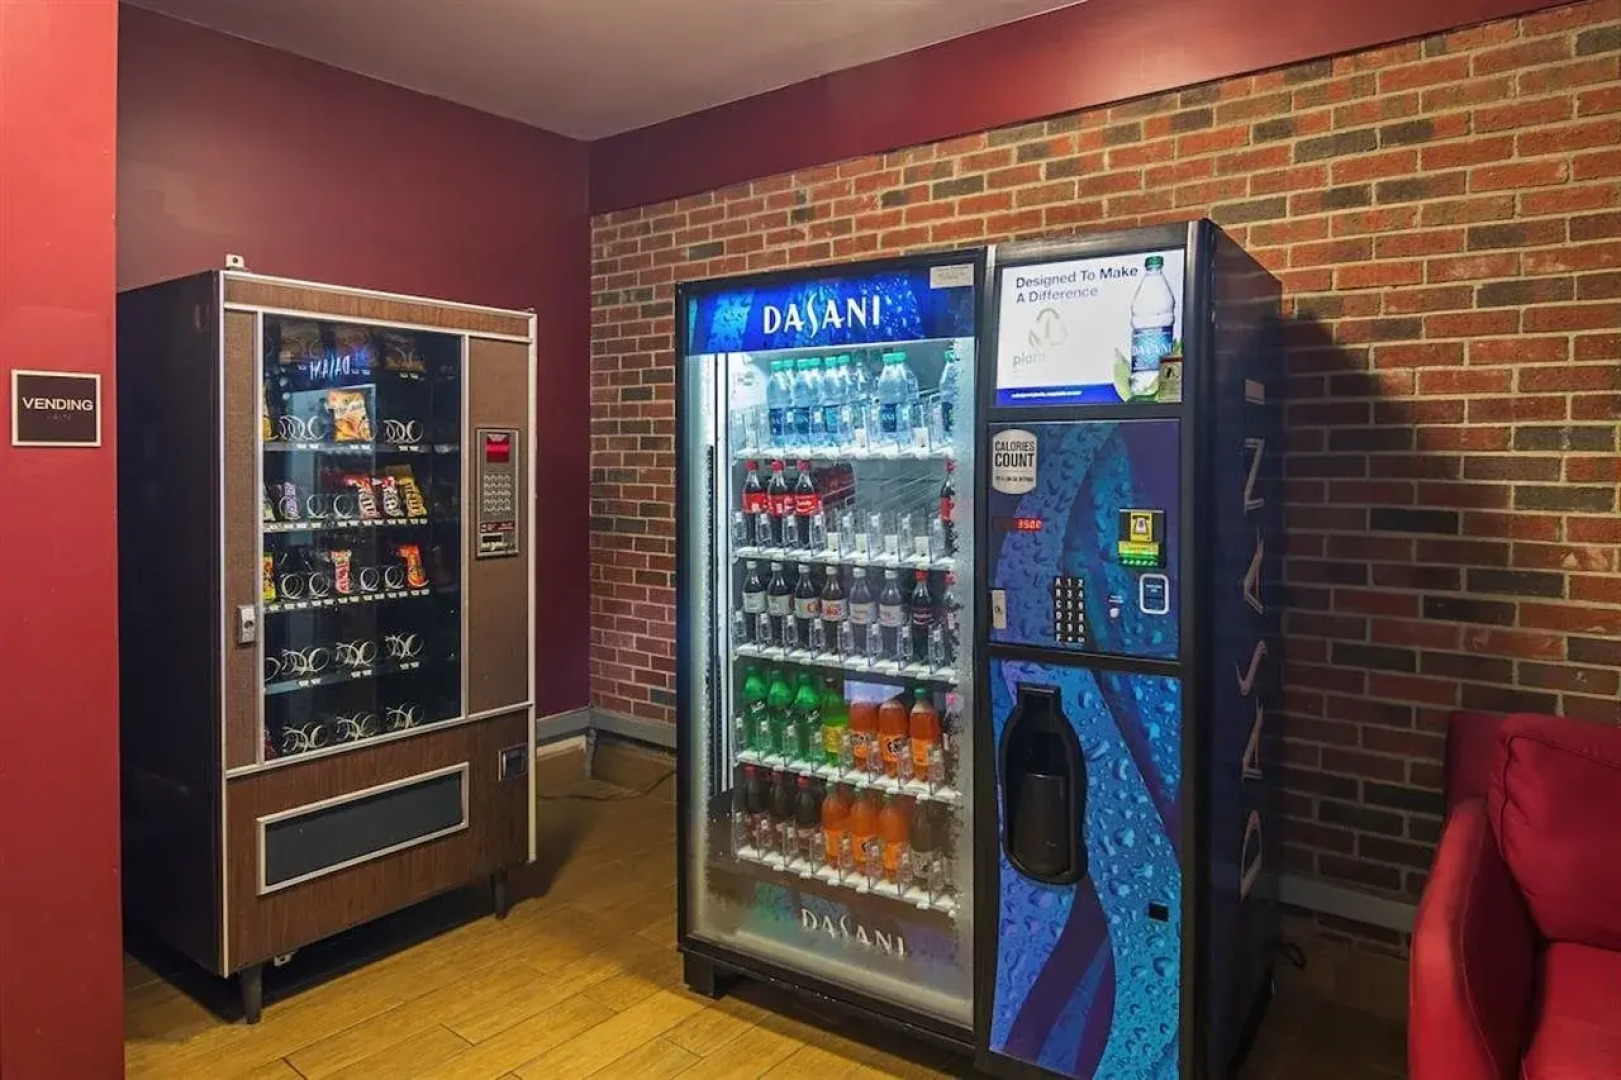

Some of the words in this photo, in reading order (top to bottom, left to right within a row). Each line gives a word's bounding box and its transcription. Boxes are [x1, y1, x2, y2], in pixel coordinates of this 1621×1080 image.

[1016, 271, 1076, 289] Designed
[1080, 269, 1095, 282] To
[1099, 266, 1138, 279] Make
[1016, 293, 1025, 304] A
[1029, 287, 1099, 302] Difference
[763, 293, 880, 339] DASANI
[22, 397, 94, 411] VENDING
[994, 440, 1035, 452] CALORIES
[994, 452, 1034, 468] COUNT
[801, 908, 906, 957] DASANI
